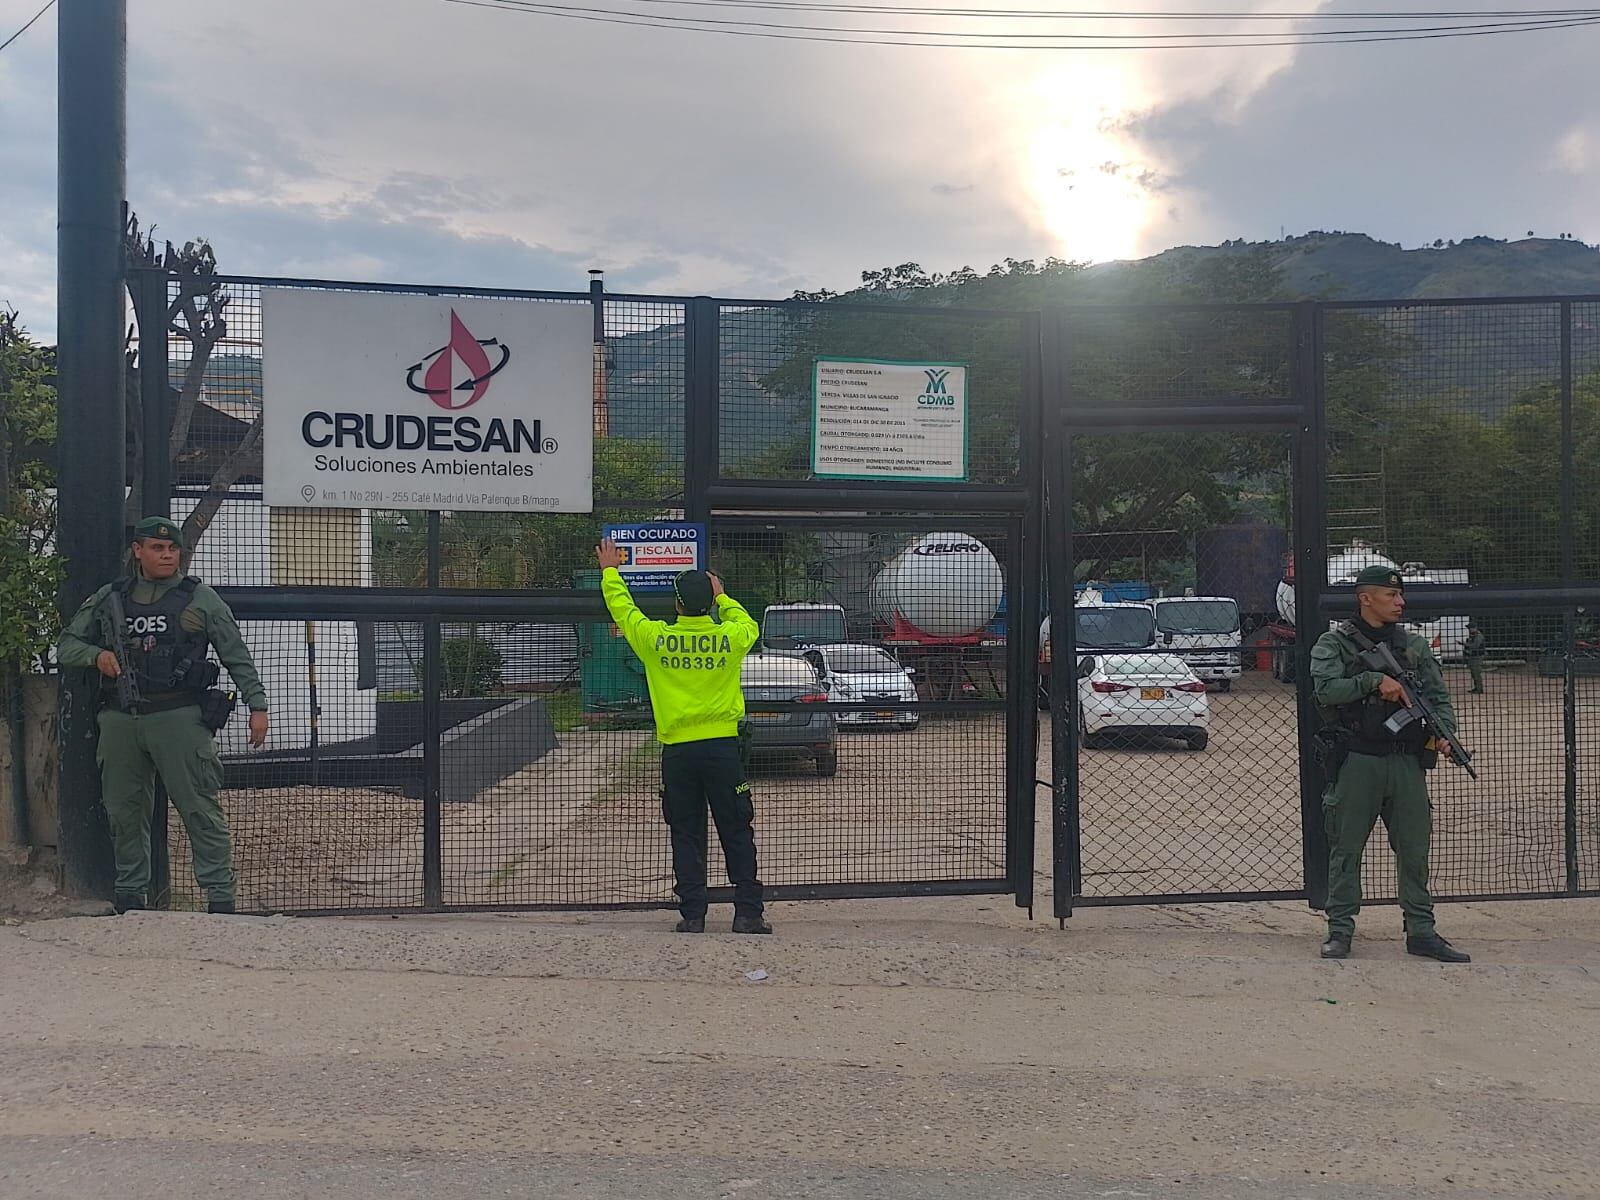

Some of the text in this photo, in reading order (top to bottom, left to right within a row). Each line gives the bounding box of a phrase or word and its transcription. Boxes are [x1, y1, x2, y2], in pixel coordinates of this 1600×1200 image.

[917, 394, 955, 406] CDMB
[315, 454, 534, 477] Soluciones Ambientales
[350, 491, 363, 502] No
[365, 491, 383, 502] 29N
[392, 491, 409, 502] 255
[433, 492, 464, 504] Madrid
[481, 494, 519, 508] Palenque
[522, 495, 560, 508] B/manga
[611, 528, 697, 540] BIEN OCUPADO
[635, 544, 693, 555] FISCALÍA
[655, 634, 732, 653] POLICIA
[660, 656, 728, 671] 608384
